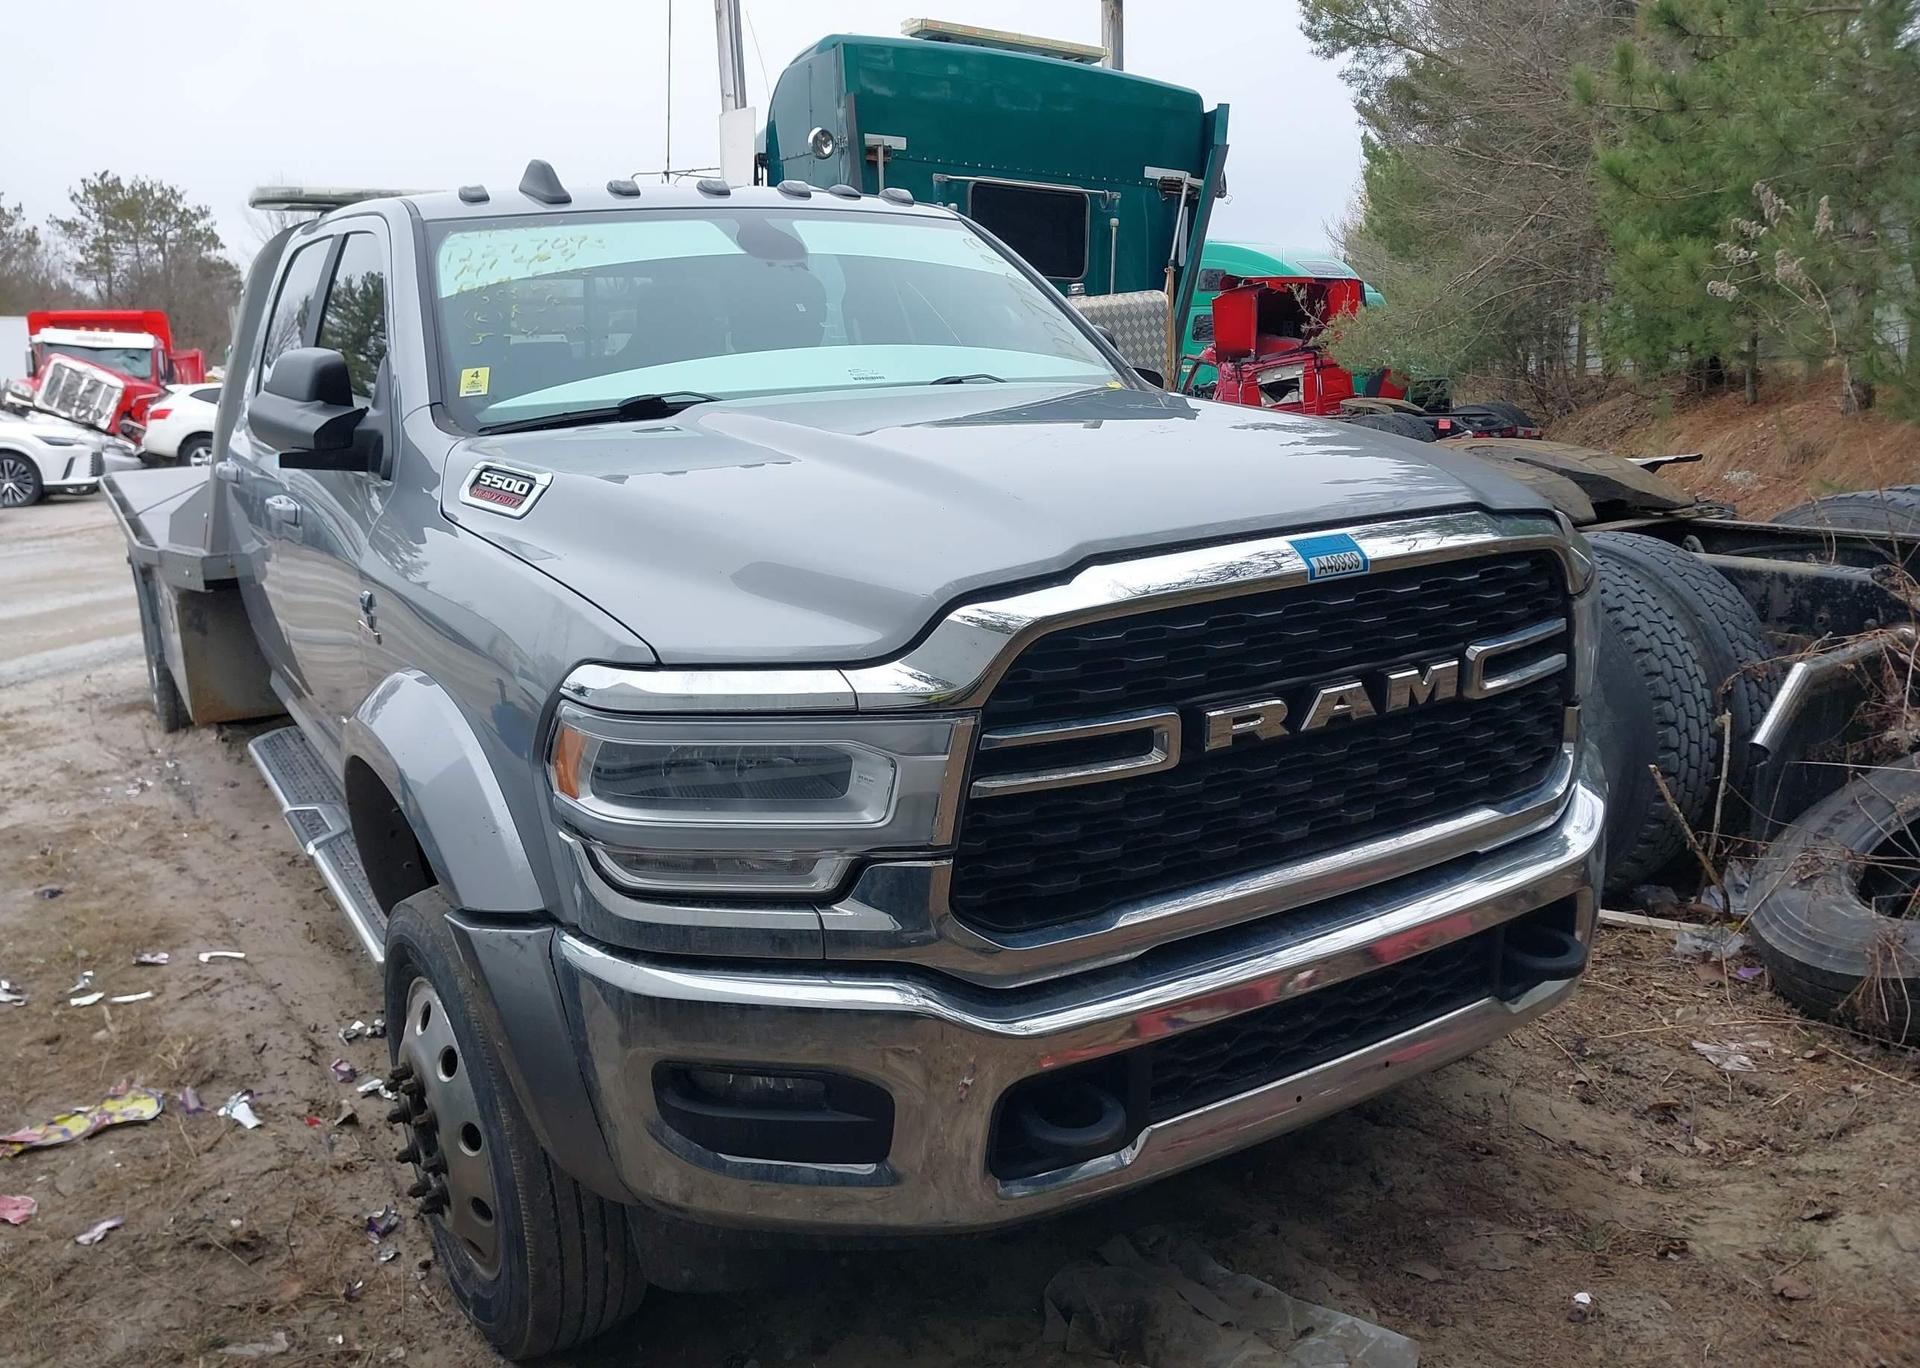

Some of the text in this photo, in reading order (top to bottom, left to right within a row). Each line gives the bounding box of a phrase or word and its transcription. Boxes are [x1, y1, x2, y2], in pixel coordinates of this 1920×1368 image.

[471, 370, 480, 379] 4
[473, 488, 498, 501] HEAVY
[479, 472, 530, 495] 5500
[1316, 552, 1361, 575] A48939
[1205, 660, 1459, 752] RAM
